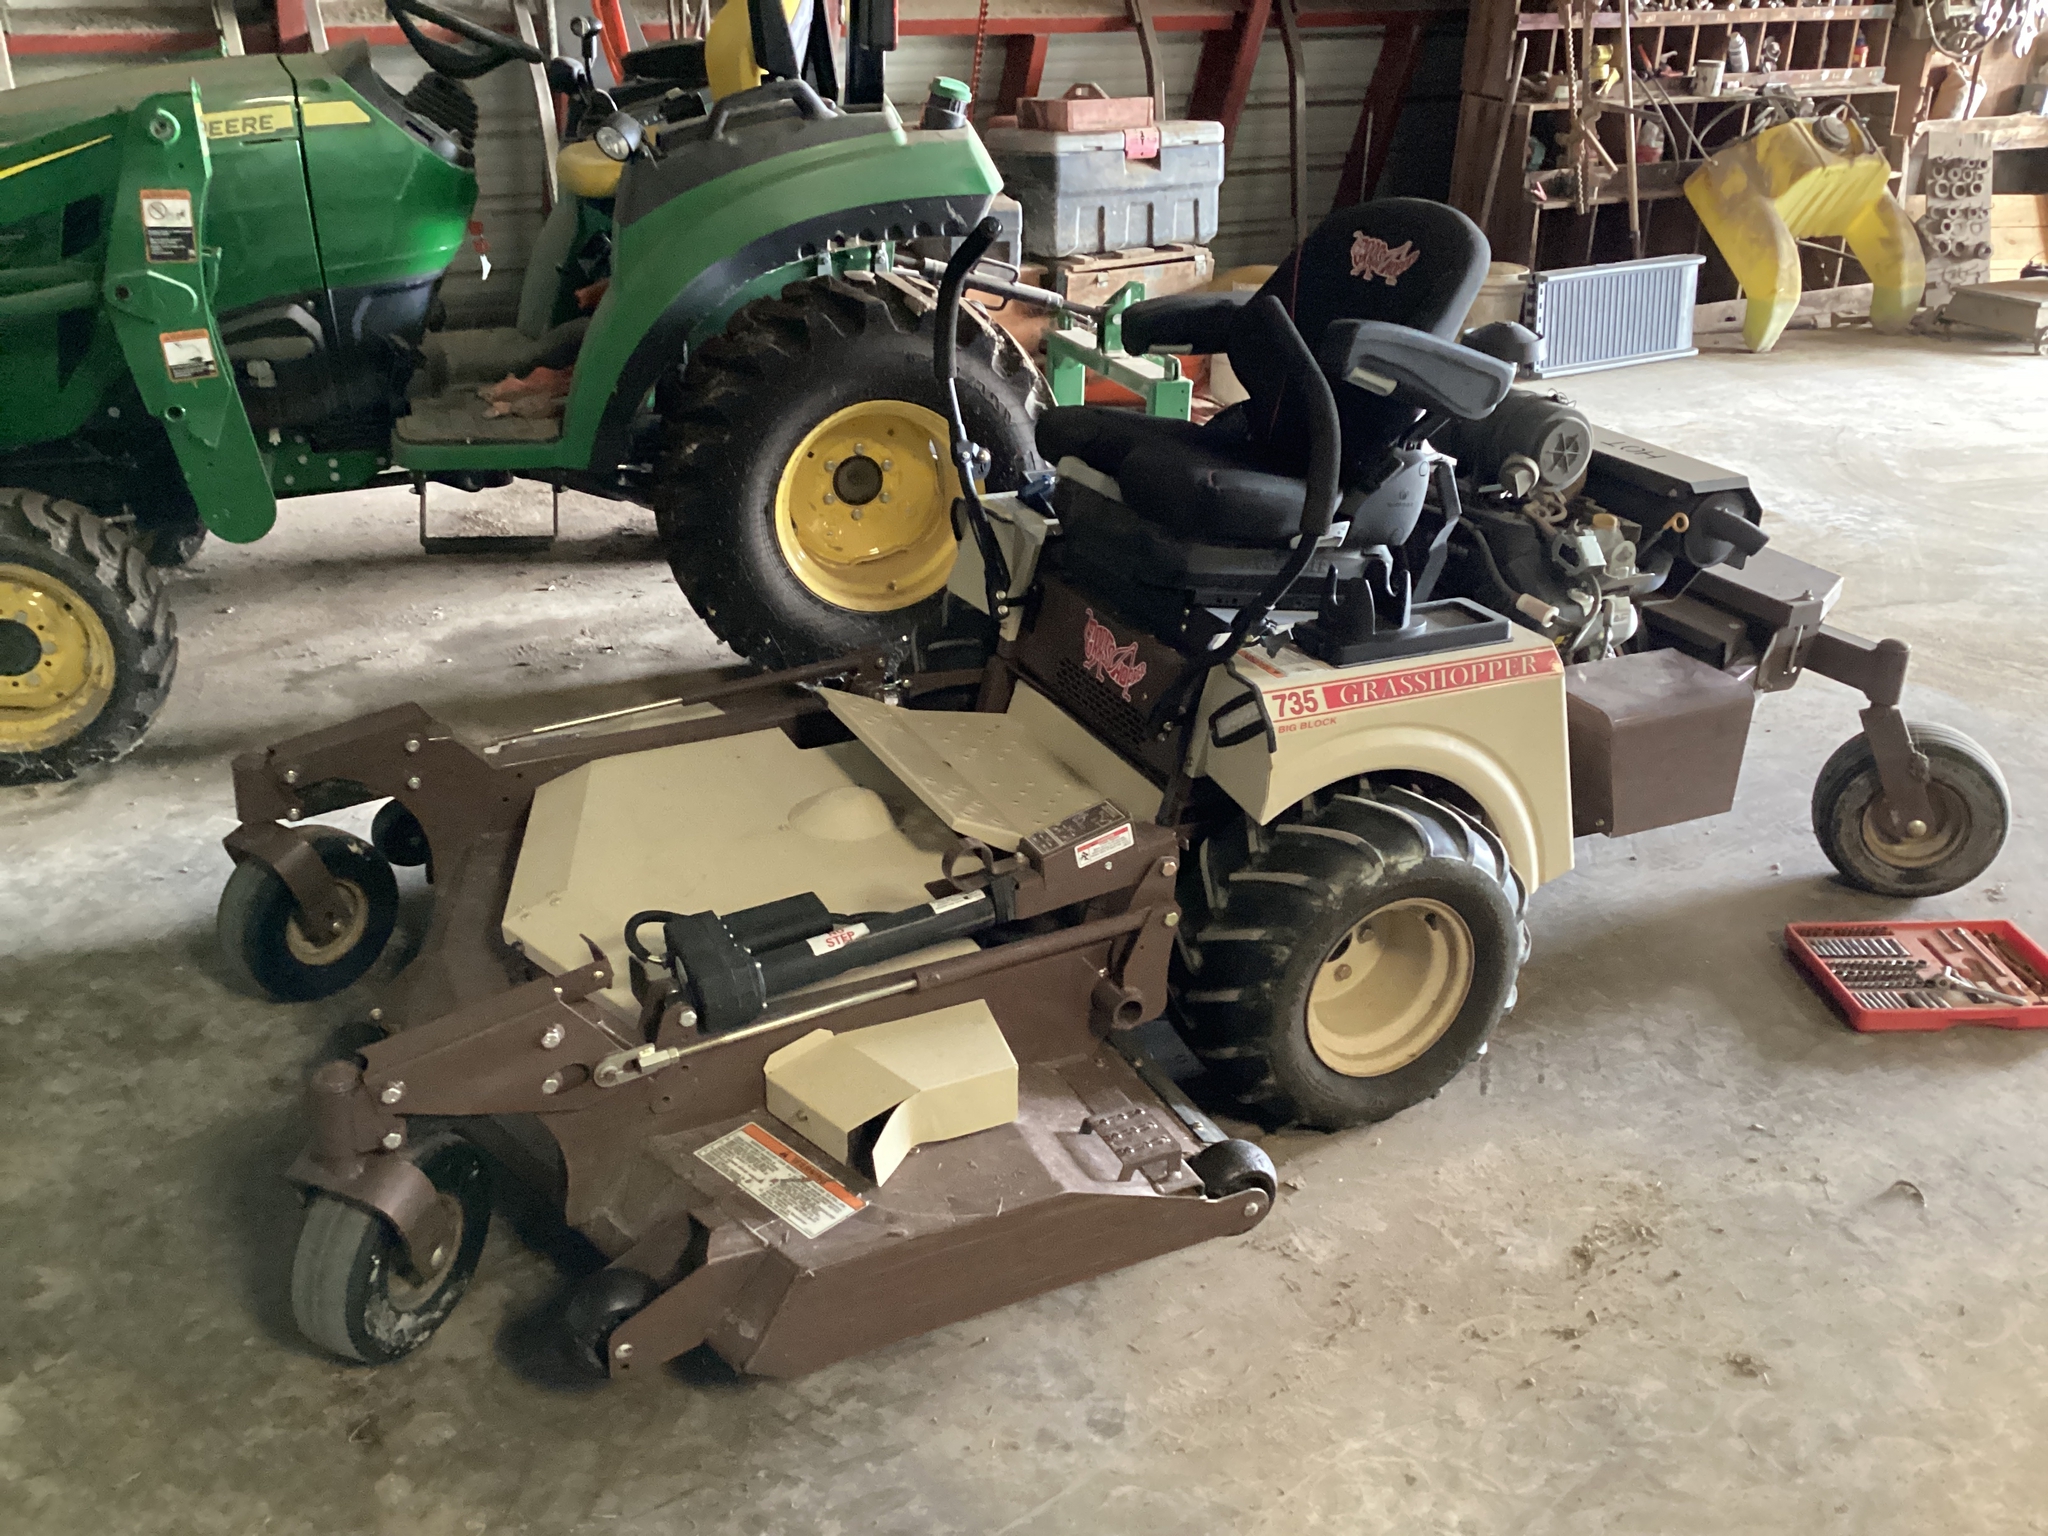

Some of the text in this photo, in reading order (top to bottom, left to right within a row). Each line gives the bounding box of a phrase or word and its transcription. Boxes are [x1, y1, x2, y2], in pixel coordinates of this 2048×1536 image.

[202, 114, 274, 136] EERE
[1600, 441, 1667, 459] HOT
[1271, 655, 1538, 717] 735 GRASSHOPPER
[1277, 716, 1337, 734] BIG BLOCK
[825, 930, 855, 948] STEP
